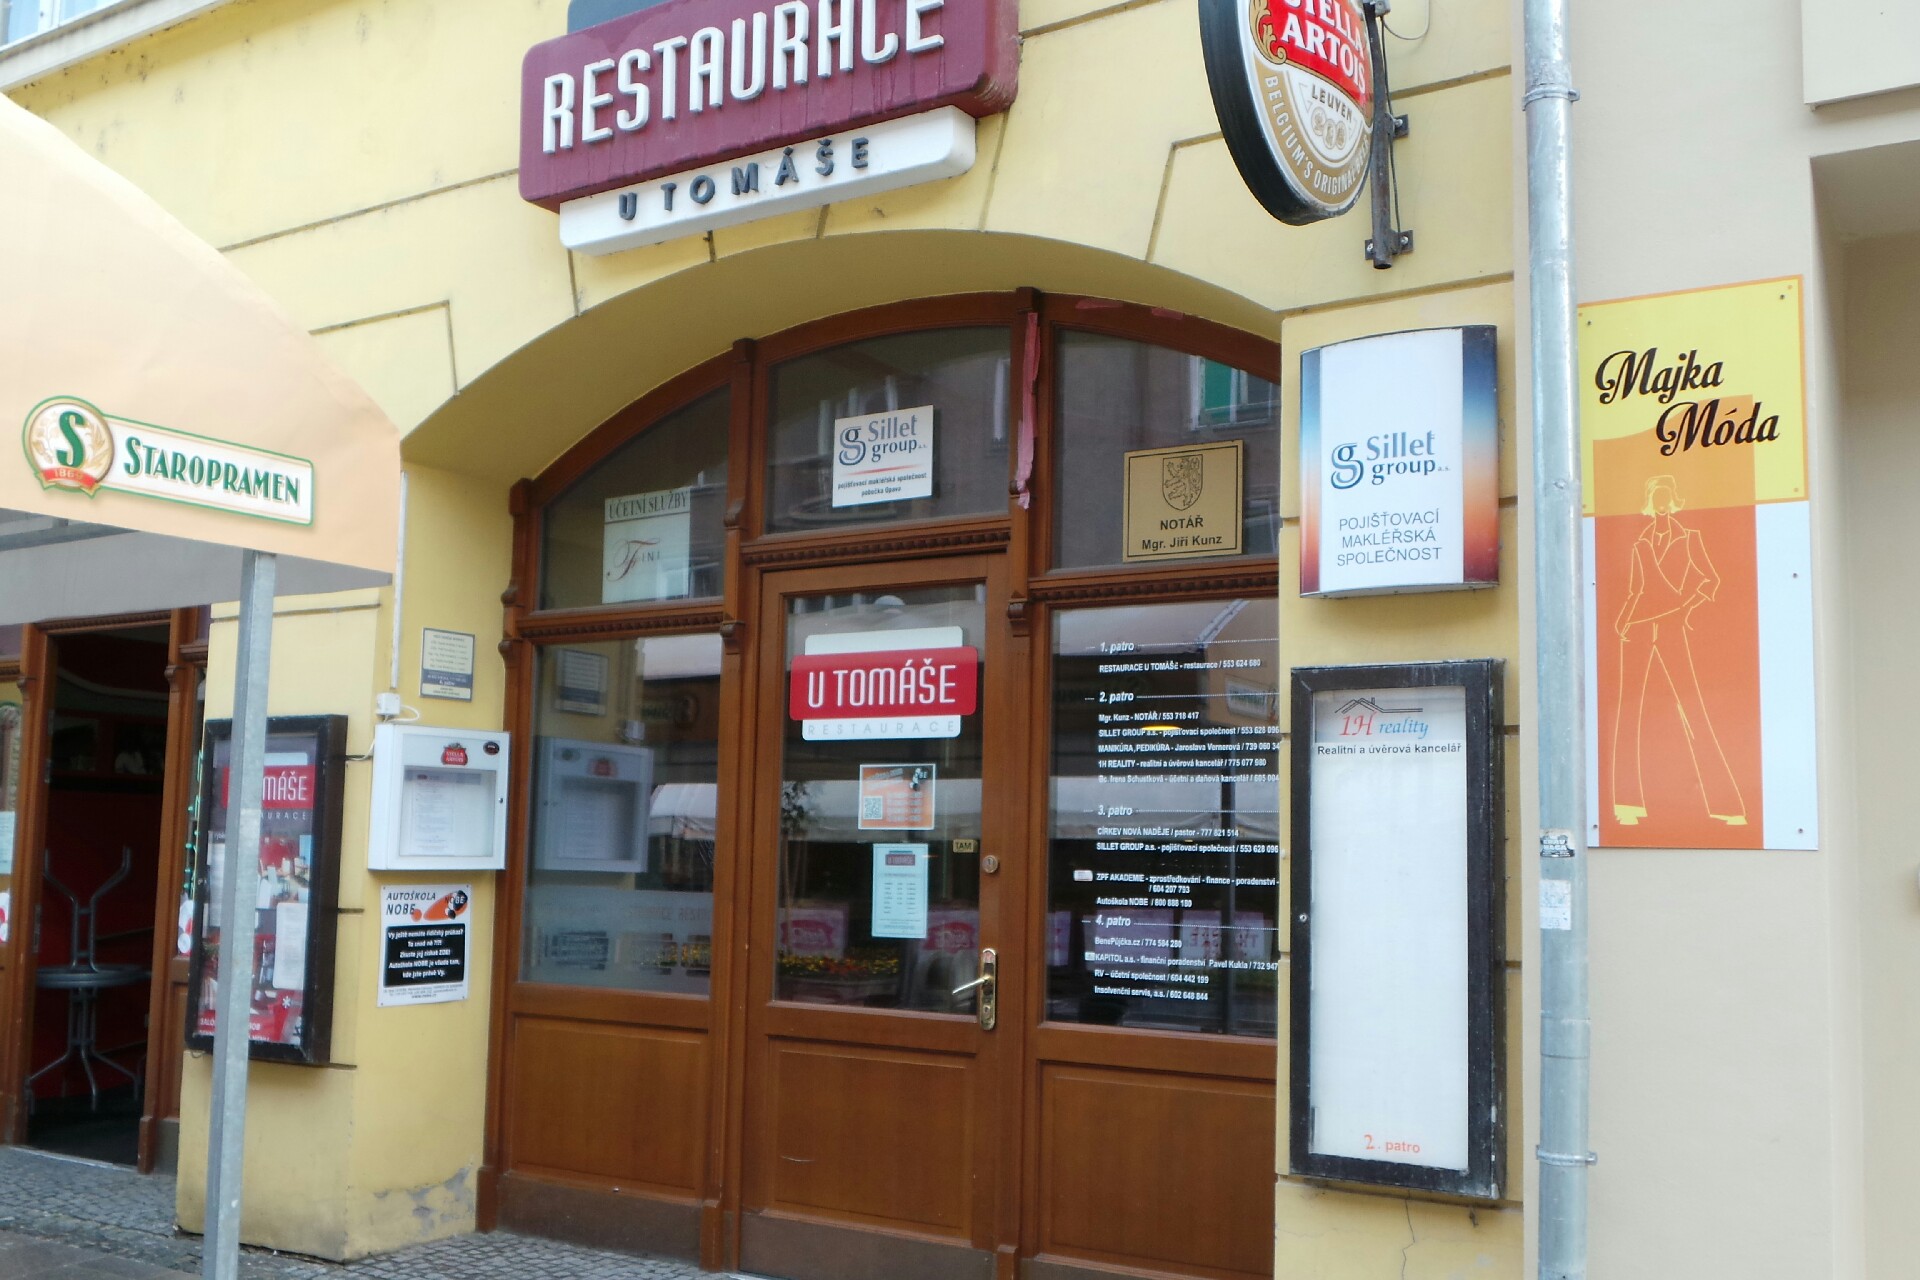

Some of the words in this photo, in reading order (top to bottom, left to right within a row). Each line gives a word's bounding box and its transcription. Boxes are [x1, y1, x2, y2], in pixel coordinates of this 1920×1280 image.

[1284, 0, 1365, 60] ELLA
[1281, 12, 1366, 94] ARTOIS
[543, 0, 944, 154] RESTAURACE
[1312, 84, 1353, 123] LEUVEN
[1264, 76, 1313, 179] BELGIUM'S
[1314, 168, 1356, 195] ORIGINAL
[619, 192, 637, 221] U
[661, 136, 869, 212] TOMÁŠE
[1595, 347, 1724, 404] Majka
[868, 414, 918, 442] Sillet
[1656, 399, 1781, 456] Móda
[872, 439, 917, 462] group
[1366, 430, 1436, 461] Sillet
[123, 436, 299, 504] STAROPRAMEN
[1371, 459, 1436, 486] group
[1160, 514, 1204, 531] NOTÁŘ
[1339, 508, 1440, 531] POJIŠŤOVACÍ
[1142, 539, 1166, 552] Mgr.
[1170, 536, 1188, 548] Jiří
[1192, 535, 1222, 546] Kunz
[1342, 526, 1436, 548] MAKLÉŘSKÁ
[1337, 545, 1442, 567] SPOLEČNOST
[1100, 642, 1108, 652] 1.
[1110, 641, 1134, 654] patro
[1100, 663, 1143, 673] RESTAURACE
[1144, 662, 1150, 671] U
[1184, 661, 1218, 670] restaurace
[1222, 659, 1235, 668] 553
[808, 671, 824, 708] U
[833, 657, 956, 707] TOMÁŠE
[1099, 692, 1107, 702] 2.
[1109, 691, 1134, 704] patro
[1113, 713, 1130, 721] Kunz
[1134, 710, 1158, 720] NOTÁŘ
[1162, 712, 1174, 720] 553
[1187, 711, 1200, 719] 417
[808, 721, 955, 736] RESTAURACE
[1098, 729, 1121, 737] SILLET
[1200, 727, 1236, 736] společnost
[1379, 716, 1429, 739] reality
[1174, 743, 1206, 752] Jaroslava
[1245, 742, 1257, 751] 739
[1317, 745, 1357, 755] Realitní
[1370, 744, 1411, 755] úvěrová
[1415, 742, 1462, 754] kancelář
[1108, 759, 1136, 768] REALITY
[262, 770, 307, 801] MÁŠE
[261, 811, 306, 820] URACE
[1097, 805, 1106, 815] 3.
[1107, 806, 1133, 818] patro
[1097, 826, 1121, 836] CÍRKEV
[1122, 825, 1142, 836] NOVÁ
[1143, 826, 1169, 836] NADĚJE
[1174, 829, 1196, 837] pastor
[1200, 828, 1212, 836] 777
[1096, 842, 1119, 850] SILLET
[1120, 842, 1144, 850] GROUP
[1199, 844, 1235, 853] společnost
[1240, 844, 1252, 852] 553
[1206, 876, 1230, 884] finance
[1236, 877, 1276, 886] poradenství
[387, 890, 436, 901] AUTOŠKOLA
[1096, 897, 1128, 905] Autoškola
[386, 904, 416, 916] NOBE
[1095, 914, 1104, 926] 4.
[1106, 916, 1131, 928] patro
[1144, 938, 1157, 946] 774
[1095, 953, 1123, 962] KAPITOL
[1140, 955, 1167, 965] finanční
[1167, 957, 1206, 967] poradenství
[1208, 958, 1228, 968] Pavel
[1253, 961, 1265, 970] 732
[1094, 969, 1104, 977] RV
[1130, 972, 1166, 981] společnost
[1183, 975, 1195, 983] 442
[1364, 1134, 1381, 1150] 2.
[1385, 1140, 1421, 1154] patro
